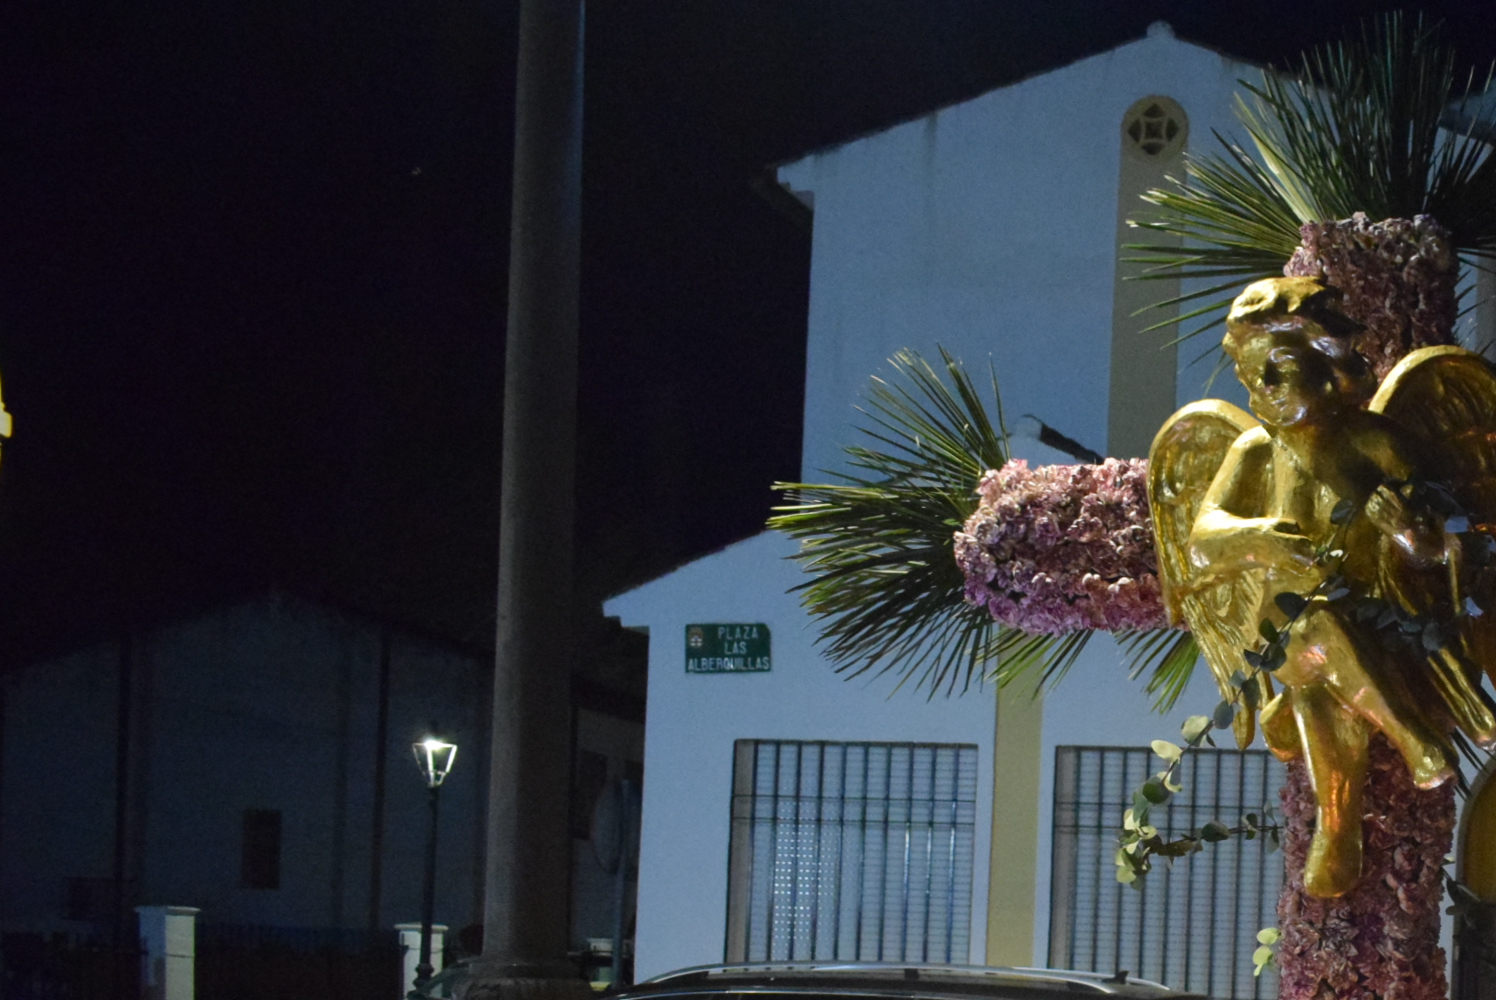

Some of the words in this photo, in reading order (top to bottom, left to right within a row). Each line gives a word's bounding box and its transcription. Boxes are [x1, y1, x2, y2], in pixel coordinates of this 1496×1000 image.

[717, 626, 760, 641] PLAZA
[724, 641, 748, 655] LAS
[687, 656, 770, 672] ALBERQUILLAS
